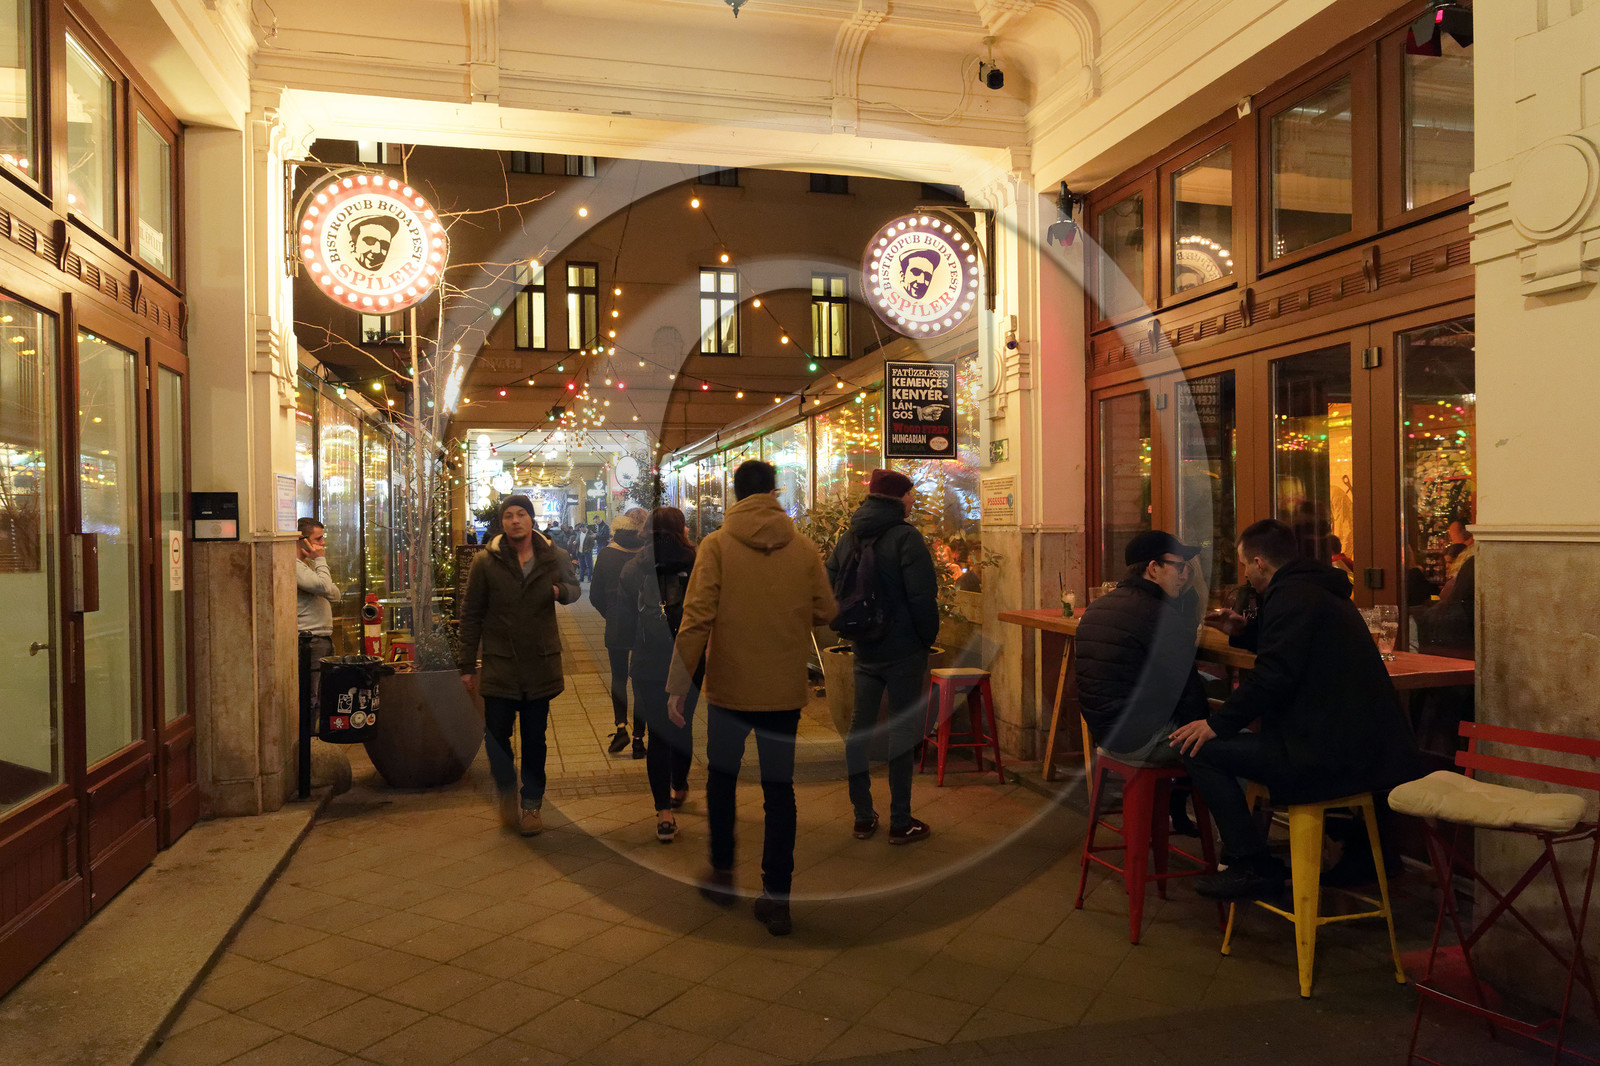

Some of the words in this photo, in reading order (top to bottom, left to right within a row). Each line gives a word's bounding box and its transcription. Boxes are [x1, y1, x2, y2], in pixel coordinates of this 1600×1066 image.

[326, 199, 373, 264] BISTROPUB
[377, 200, 423, 263] BUDAPEST
[881, 235, 920, 290] BISTROPUB
[924, 235, 959, 293] BUDAPEST
[336, 261, 419, 290] SPÍLER
[887, 291, 954, 317] SPÍLER
[892, 368, 949, 378] FATÜZELÉSES
[892, 377, 948, 388] KEMENCÉS
[892, 387, 948, 400] KENYÉR-
[892, 400, 917, 410] LÁN-
[892, 411, 913, 419] GOS
[892, 434, 926, 443] HUNGARIAN
